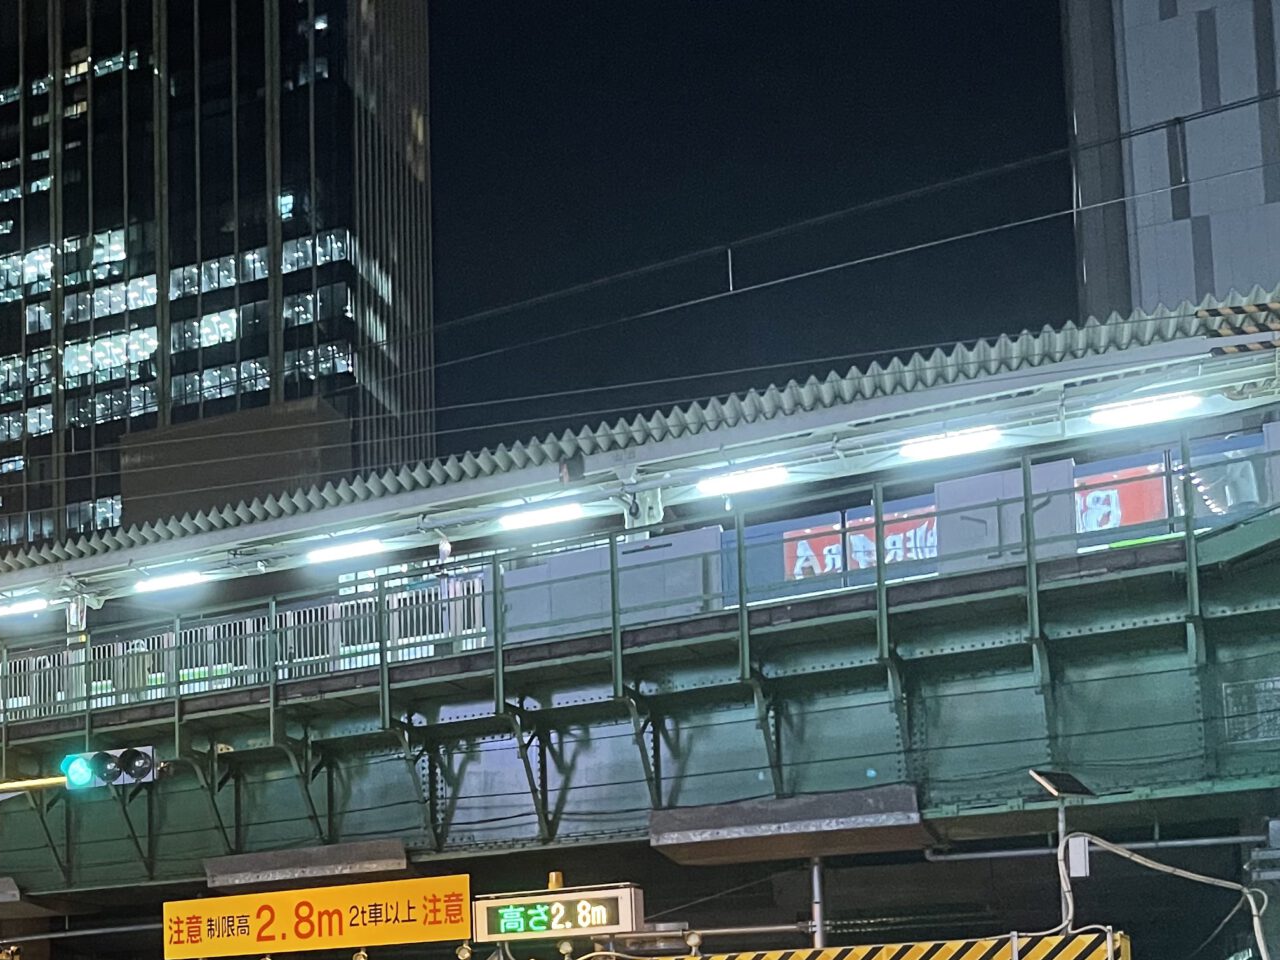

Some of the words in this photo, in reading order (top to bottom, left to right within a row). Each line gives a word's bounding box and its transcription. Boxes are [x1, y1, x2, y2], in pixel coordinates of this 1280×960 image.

[169, 915, 202, 945] 注意
[207, 915, 250, 939] 制限高
[256, 901, 344, 942] 2.8m
[349, 899, 417, 927] 2t車以上
[423, 891, 464, 926] 注意
[498, 900, 607, 933] 高さ2.8m
